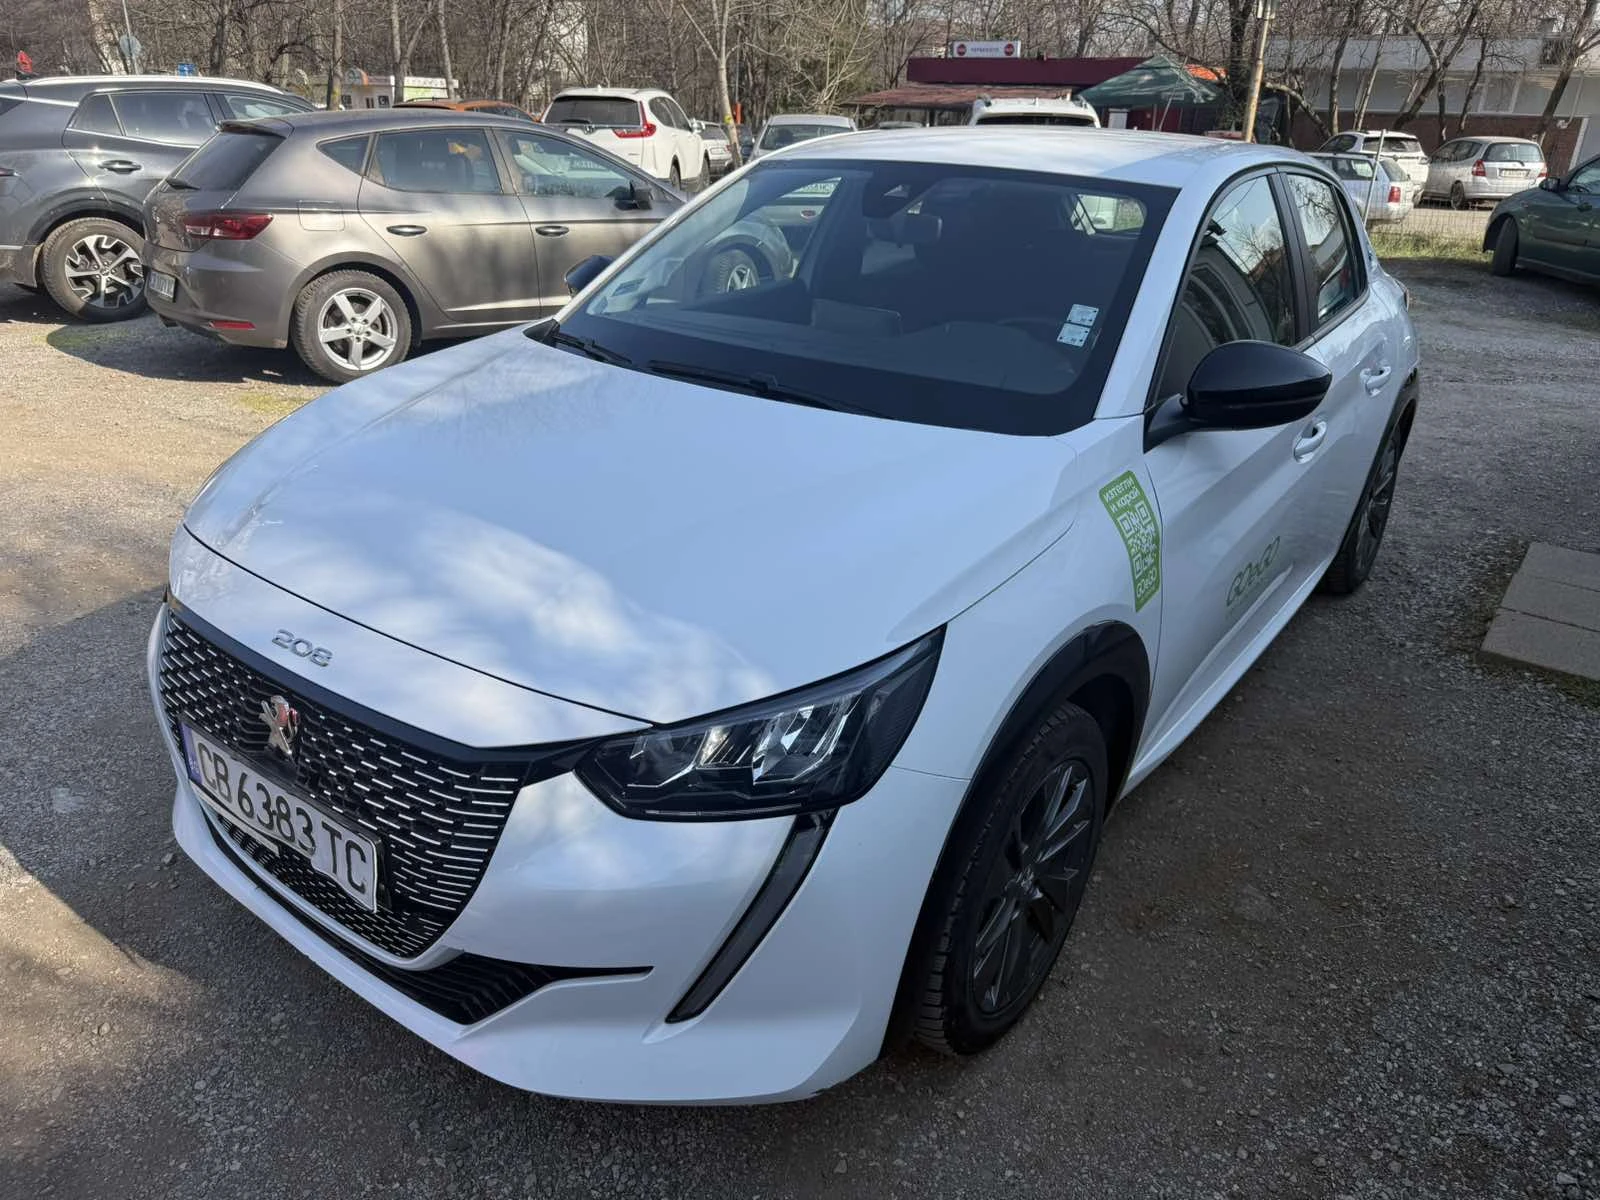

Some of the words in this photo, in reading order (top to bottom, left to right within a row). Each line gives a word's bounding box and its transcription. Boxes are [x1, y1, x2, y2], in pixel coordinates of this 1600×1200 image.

[272, 629, 332, 667] 208
[198, 742, 232, 804] CB
[238, 772, 317, 857] 6383
[322, 820, 367, 895] TC
